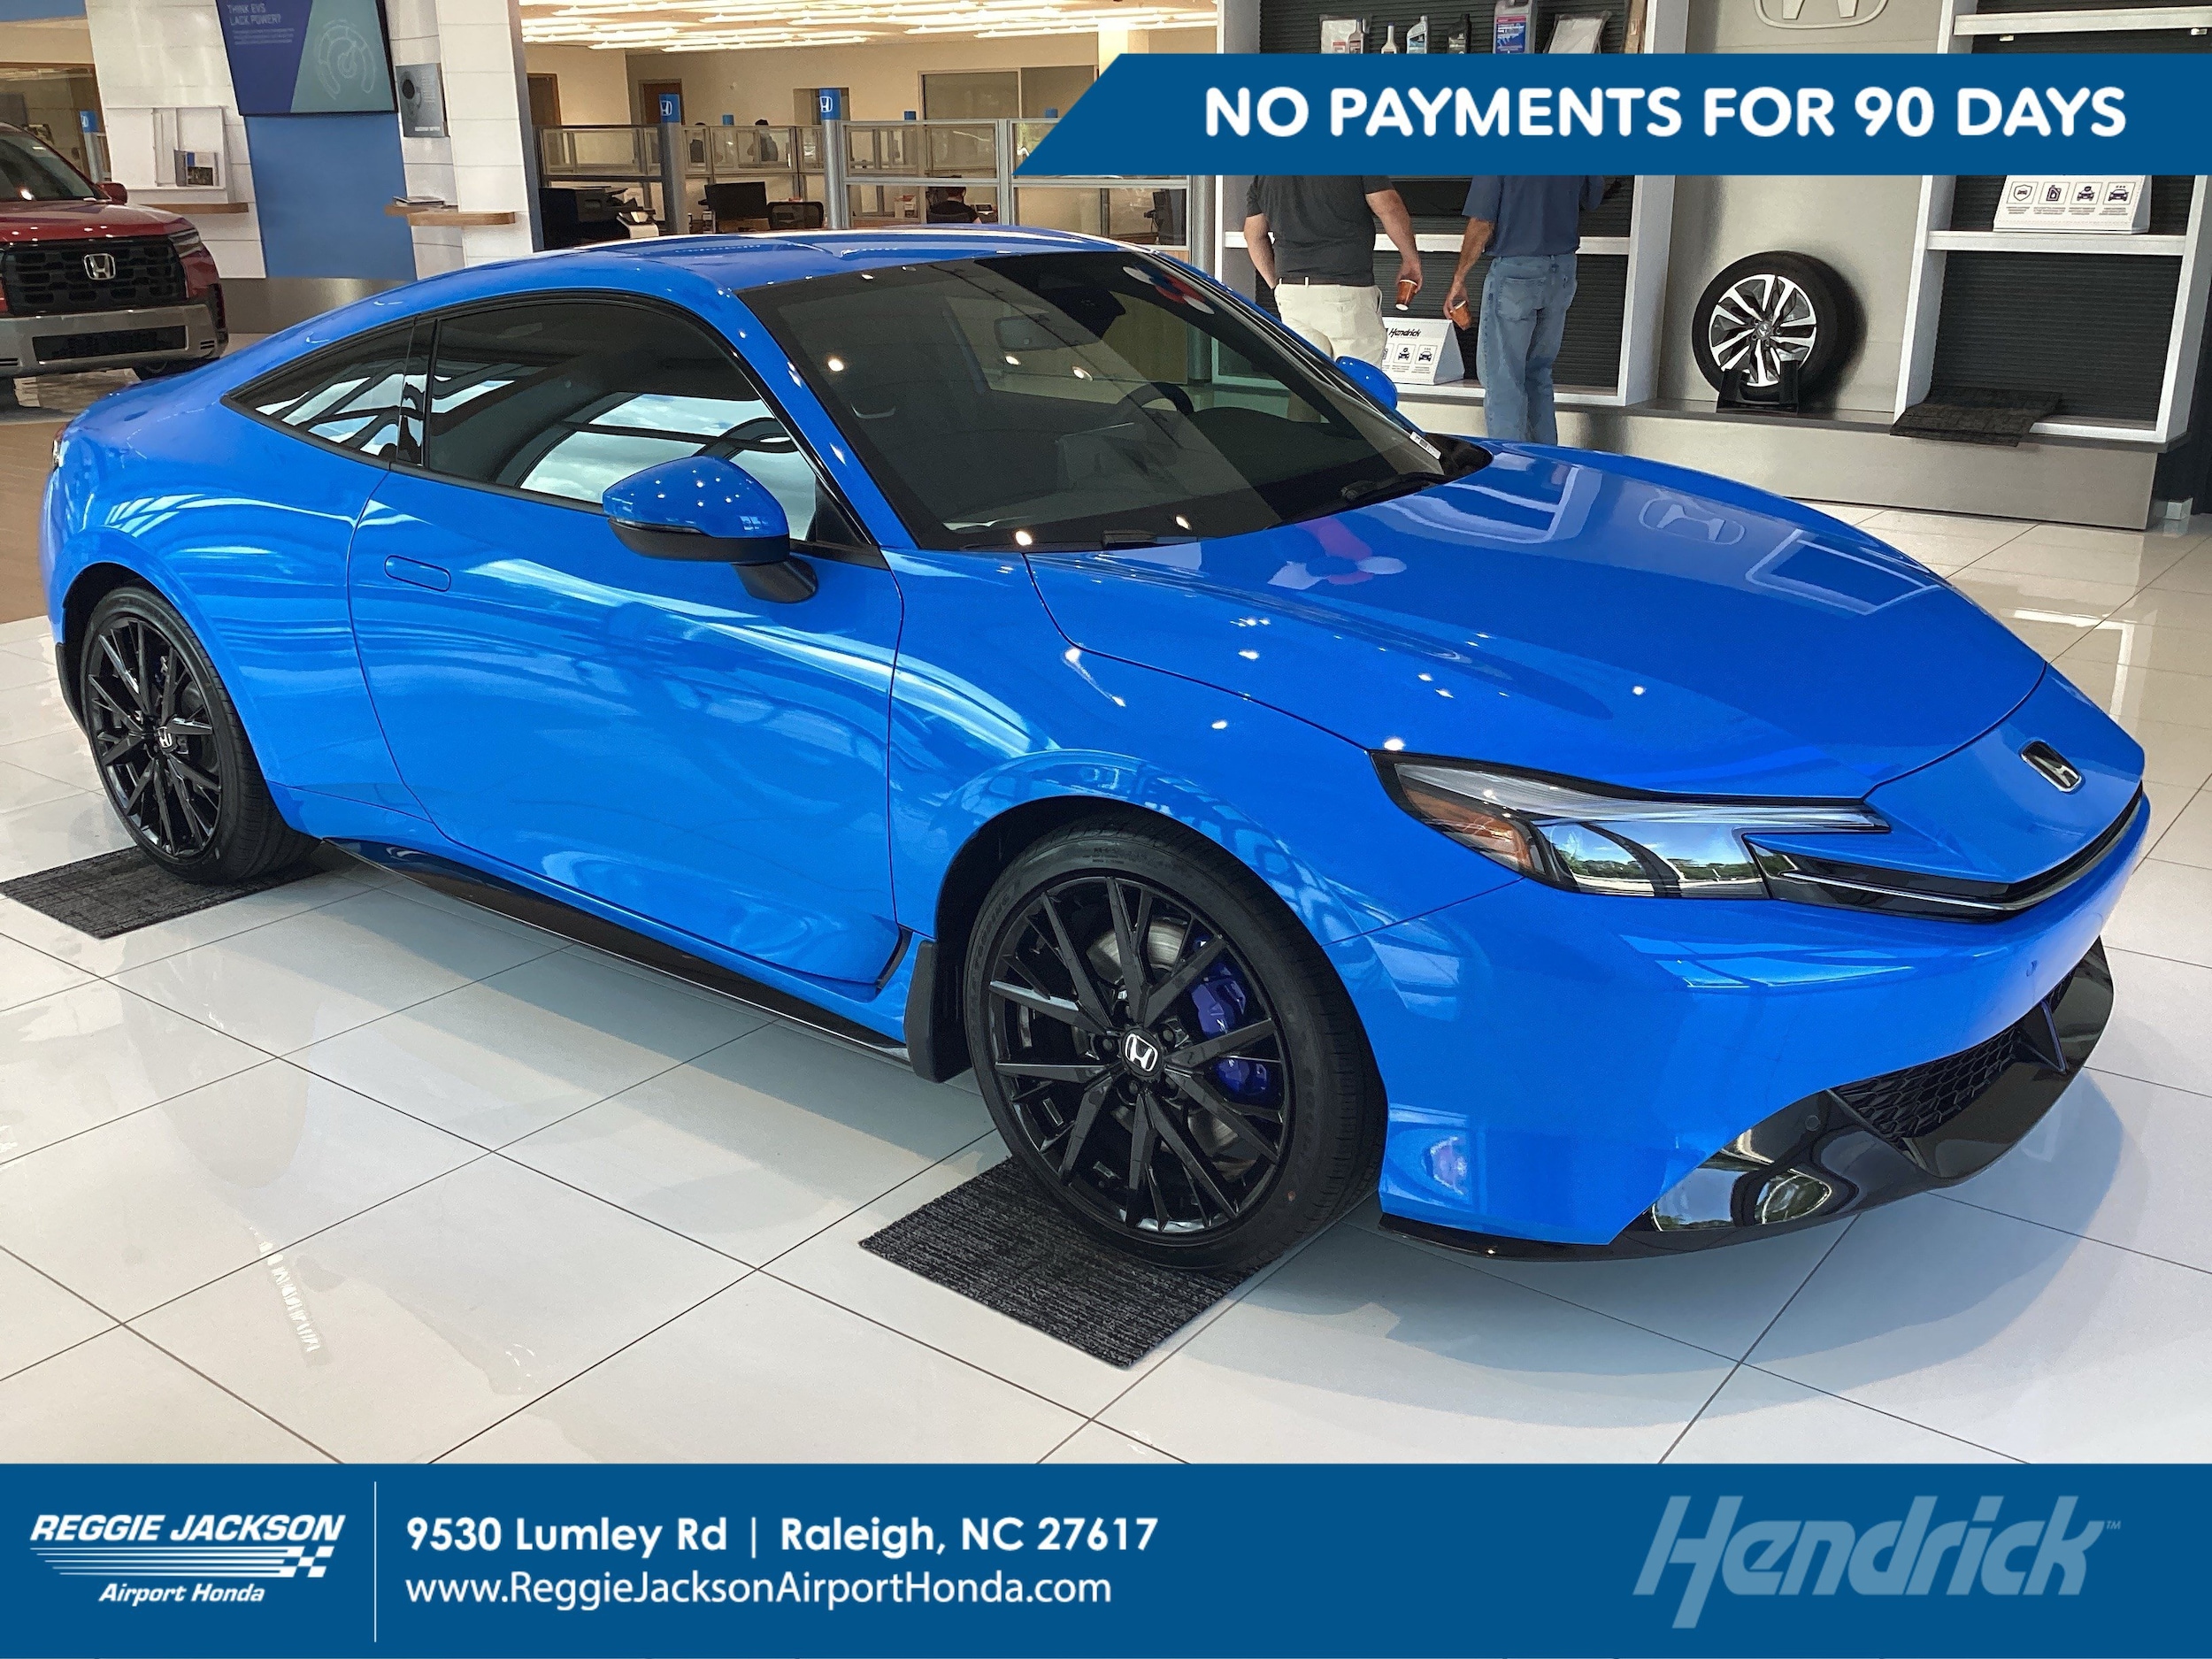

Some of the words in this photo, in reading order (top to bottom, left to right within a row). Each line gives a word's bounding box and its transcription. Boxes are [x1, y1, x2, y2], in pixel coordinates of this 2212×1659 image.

[227, 4, 250, 13] THINK
[229, 15, 250, 26] LACK
[1388, 327, 1422, 338] Hendrick
